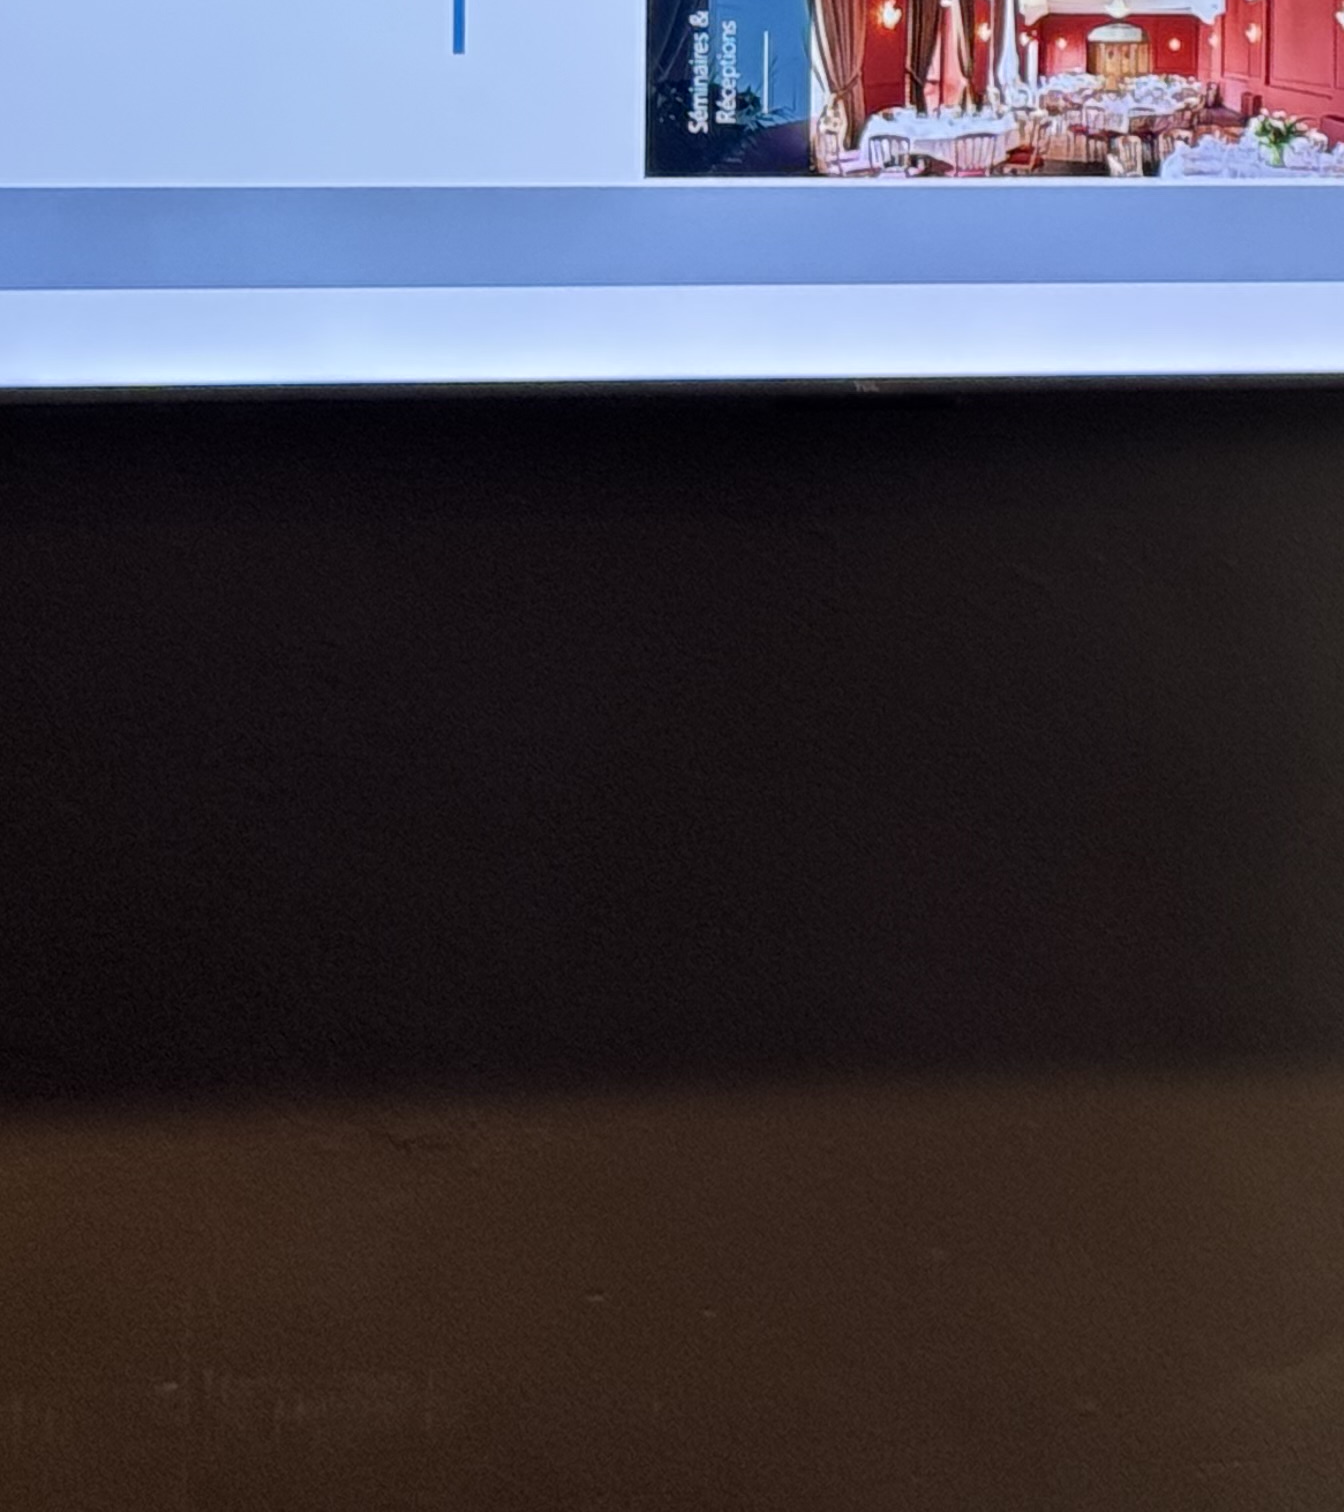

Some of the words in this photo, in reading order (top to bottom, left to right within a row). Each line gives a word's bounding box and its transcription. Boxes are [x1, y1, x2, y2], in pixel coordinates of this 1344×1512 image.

[688, 10, 710, 28] &
[687, 31, 710, 134] Séminaires
[715, 19, 741, 124] Réceptions
